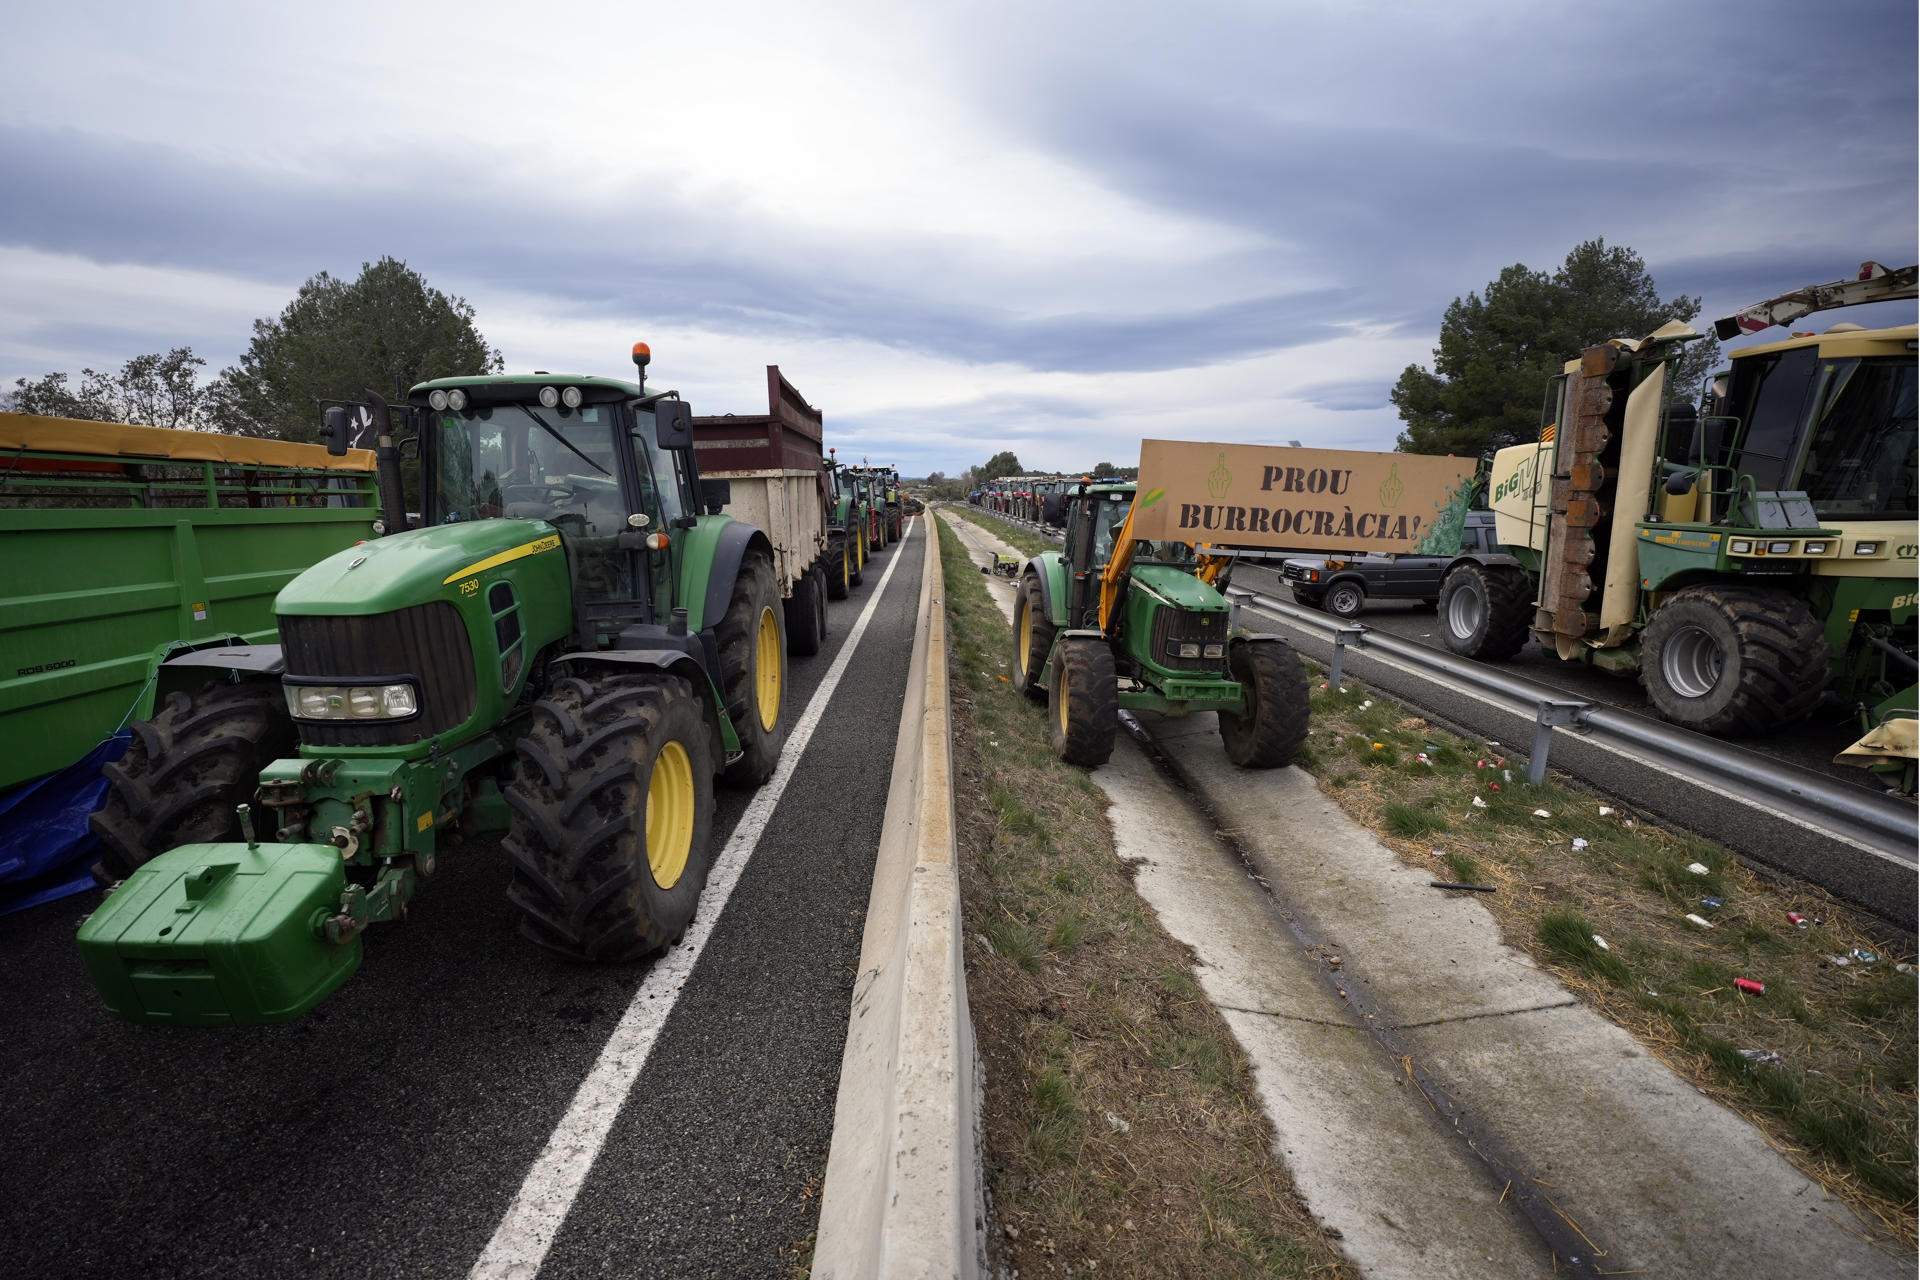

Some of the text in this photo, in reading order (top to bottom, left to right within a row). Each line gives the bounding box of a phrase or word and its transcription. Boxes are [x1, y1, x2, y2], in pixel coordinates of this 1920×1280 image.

[1260, 465, 1353, 495] PROU
[1495, 472, 1519, 503] BiG
[1178, 503, 1422, 541] BURROCRÀCIA!
[459, 579, 479, 595] 7530
